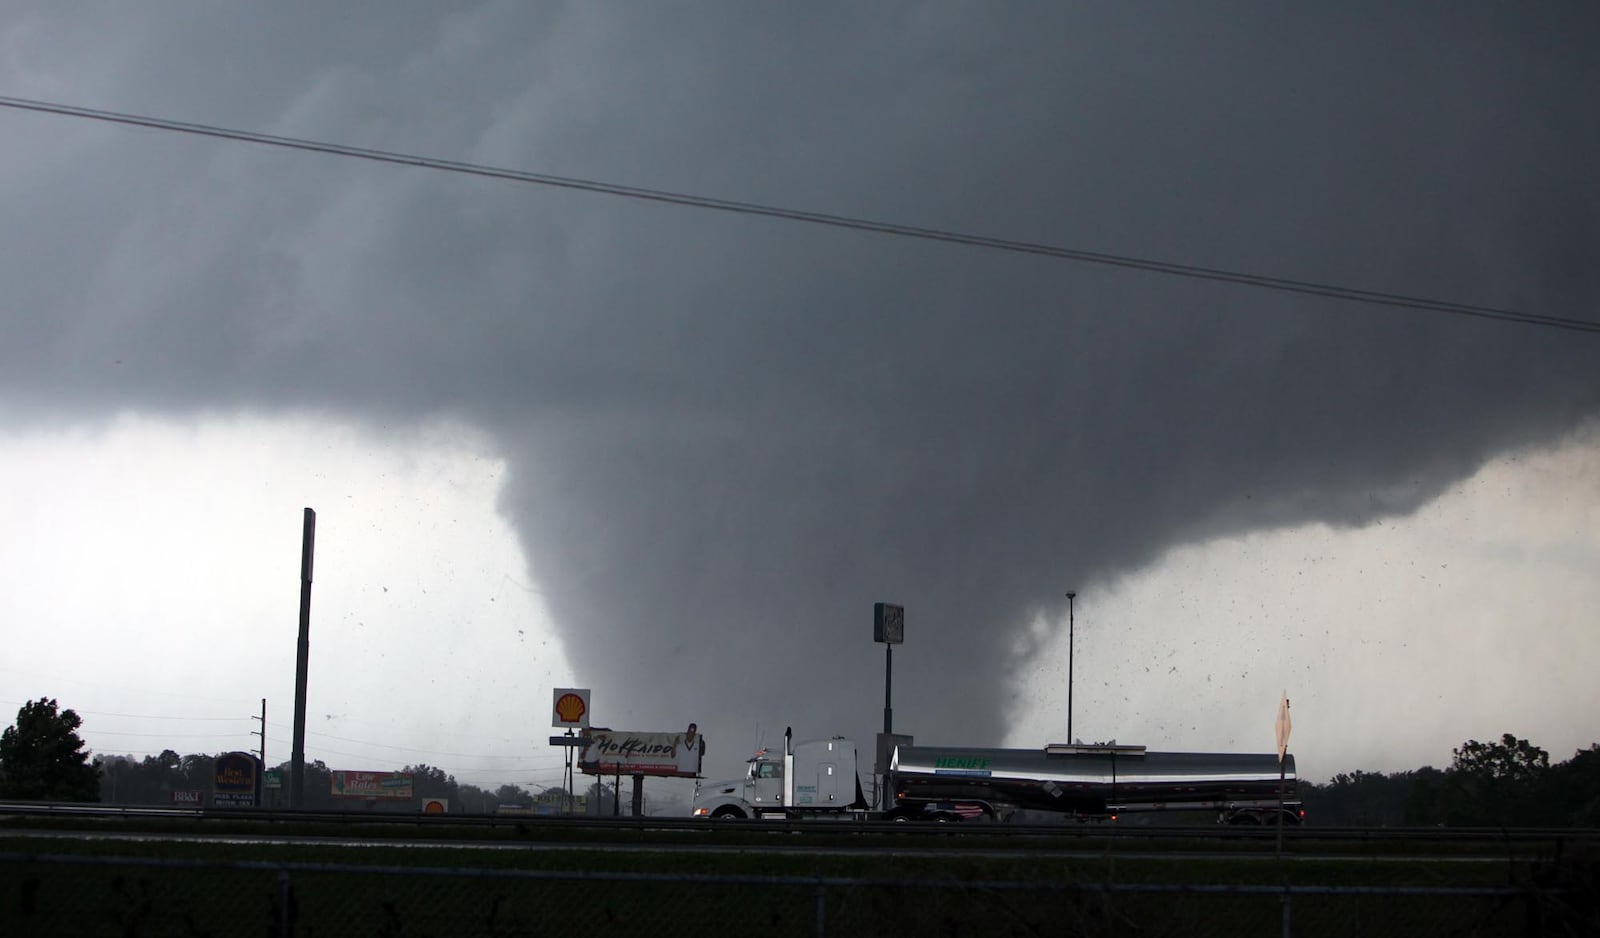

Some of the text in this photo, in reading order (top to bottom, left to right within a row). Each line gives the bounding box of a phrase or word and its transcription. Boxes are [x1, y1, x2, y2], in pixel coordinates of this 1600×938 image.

[936, 757, 992, 769] HENIFF
[224, 768, 243, 777] Best
[356, 773, 374, 781] Low
[216, 776, 252, 785] Western
[351, 780, 377, 790] Rates
[174, 792, 200, 801] BB&T
